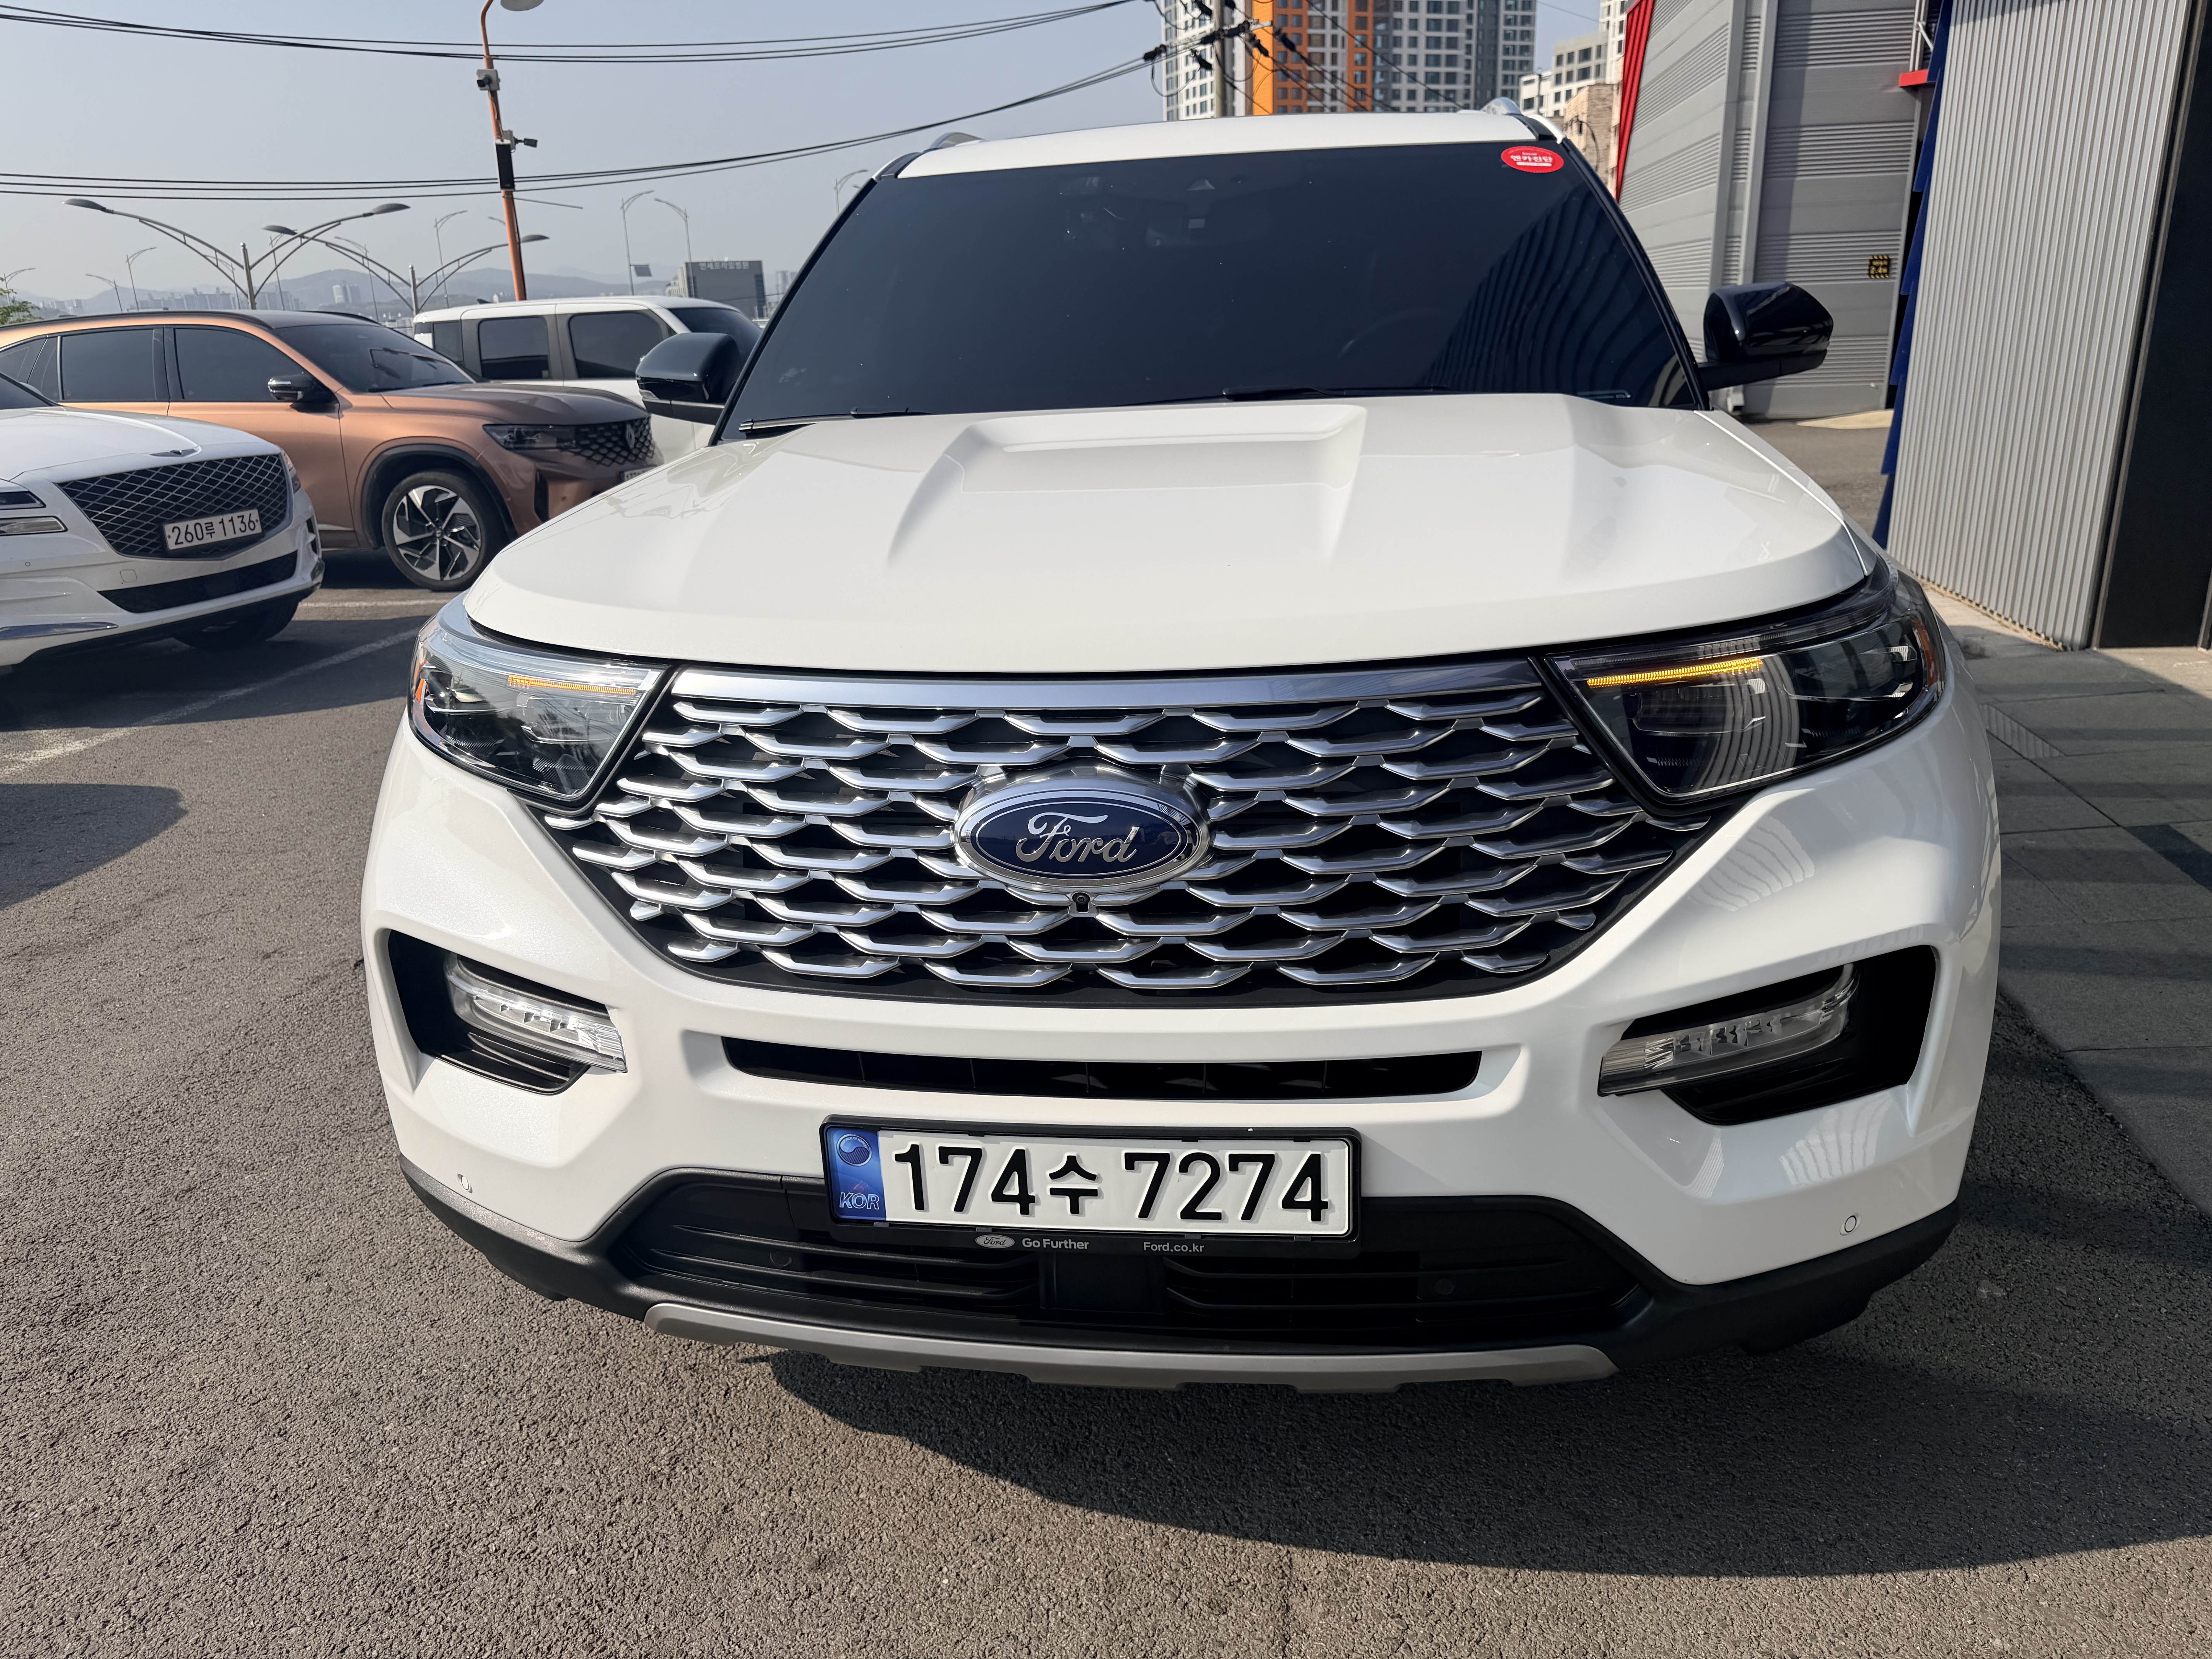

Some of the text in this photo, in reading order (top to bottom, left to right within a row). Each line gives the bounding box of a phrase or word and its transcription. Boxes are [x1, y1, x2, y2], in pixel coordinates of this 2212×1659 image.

[172, 513, 256, 545] 260루 1136
[1015, 812, 1139, 863] Ford
[894, 1144, 1329, 1222] 174수 7274
[839, 1192, 879, 1210] KOR
[984, 1237, 1006, 1245] Ford
[1022, 1238, 1089, 1249] Go Further
[1143, 1242, 1204, 1252] Ford.co.kr
